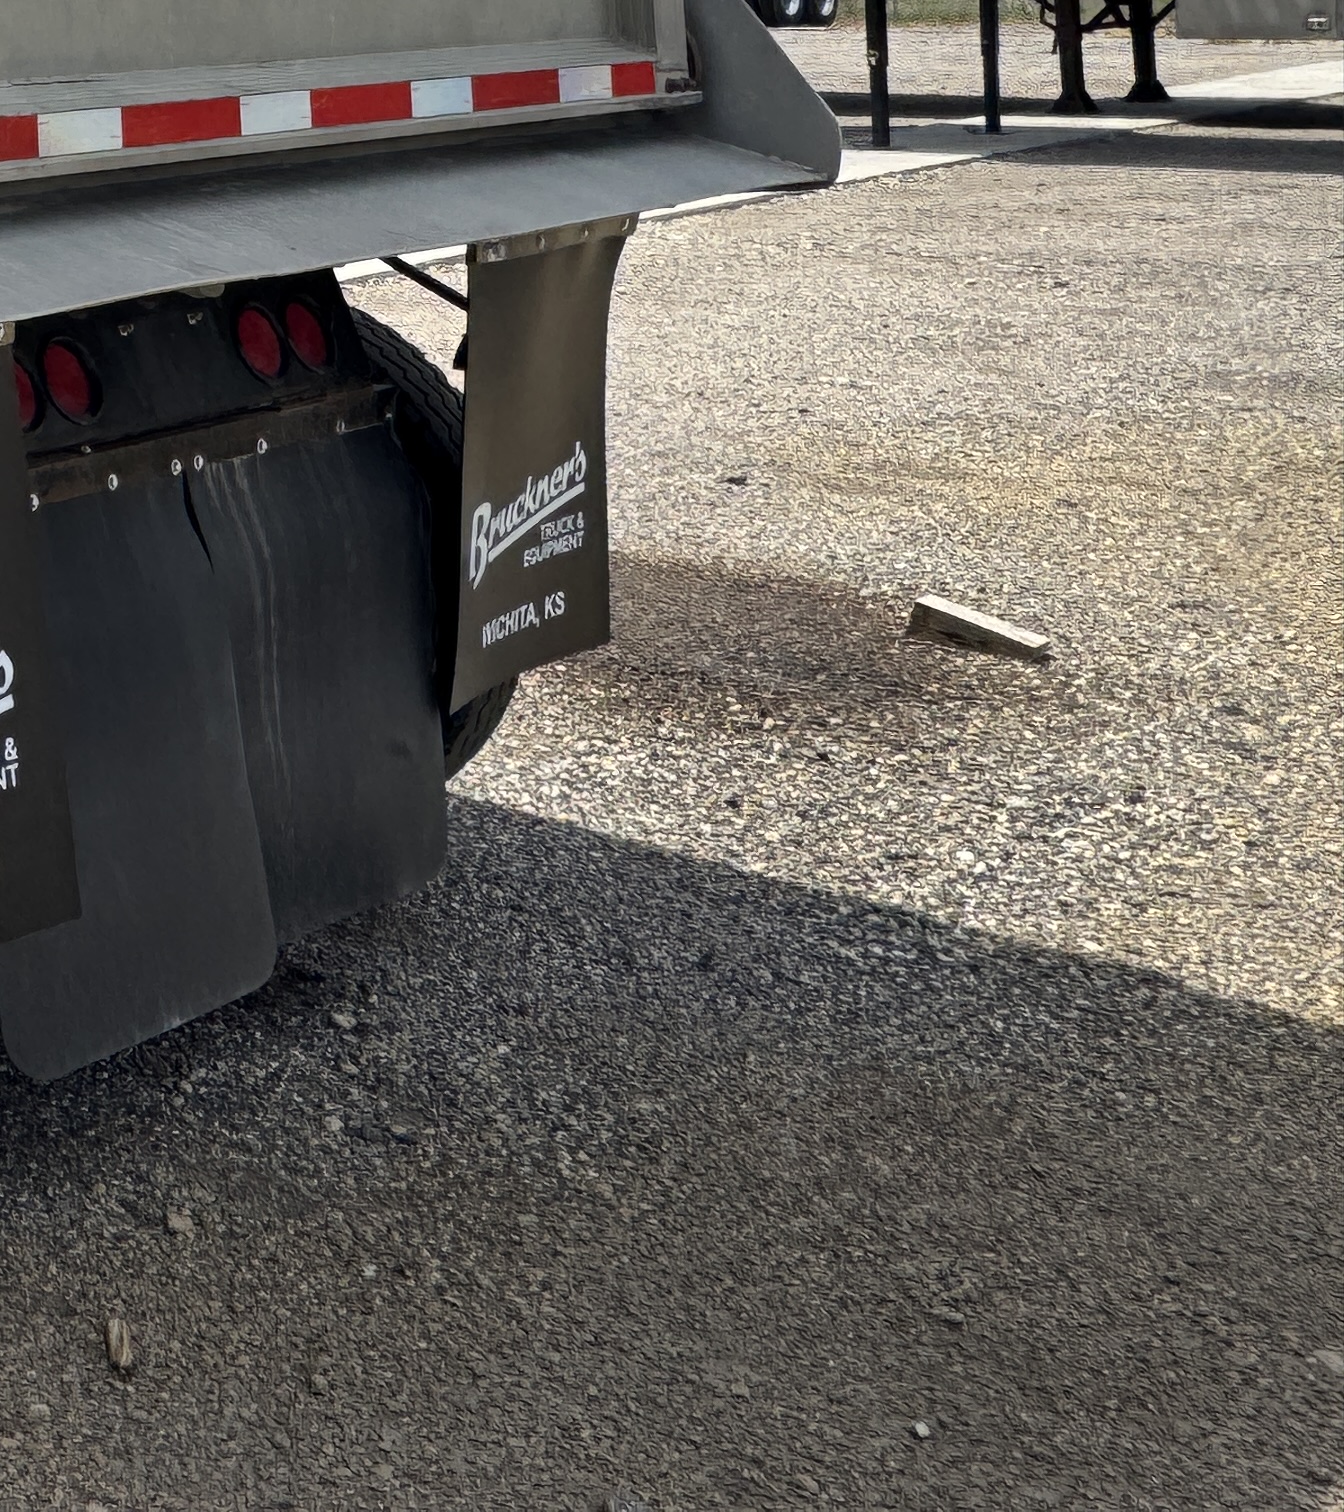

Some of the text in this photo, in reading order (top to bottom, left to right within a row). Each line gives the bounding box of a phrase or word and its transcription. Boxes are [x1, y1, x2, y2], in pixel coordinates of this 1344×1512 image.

[468, 441, 587, 590] Bruckner's
[540, 511, 584, 542] TRUCK &
[523, 530, 584, 567] EQUIPMENT
[482, 591, 566, 649] WICHITA, KS
[5, 737, 19, 761] &
